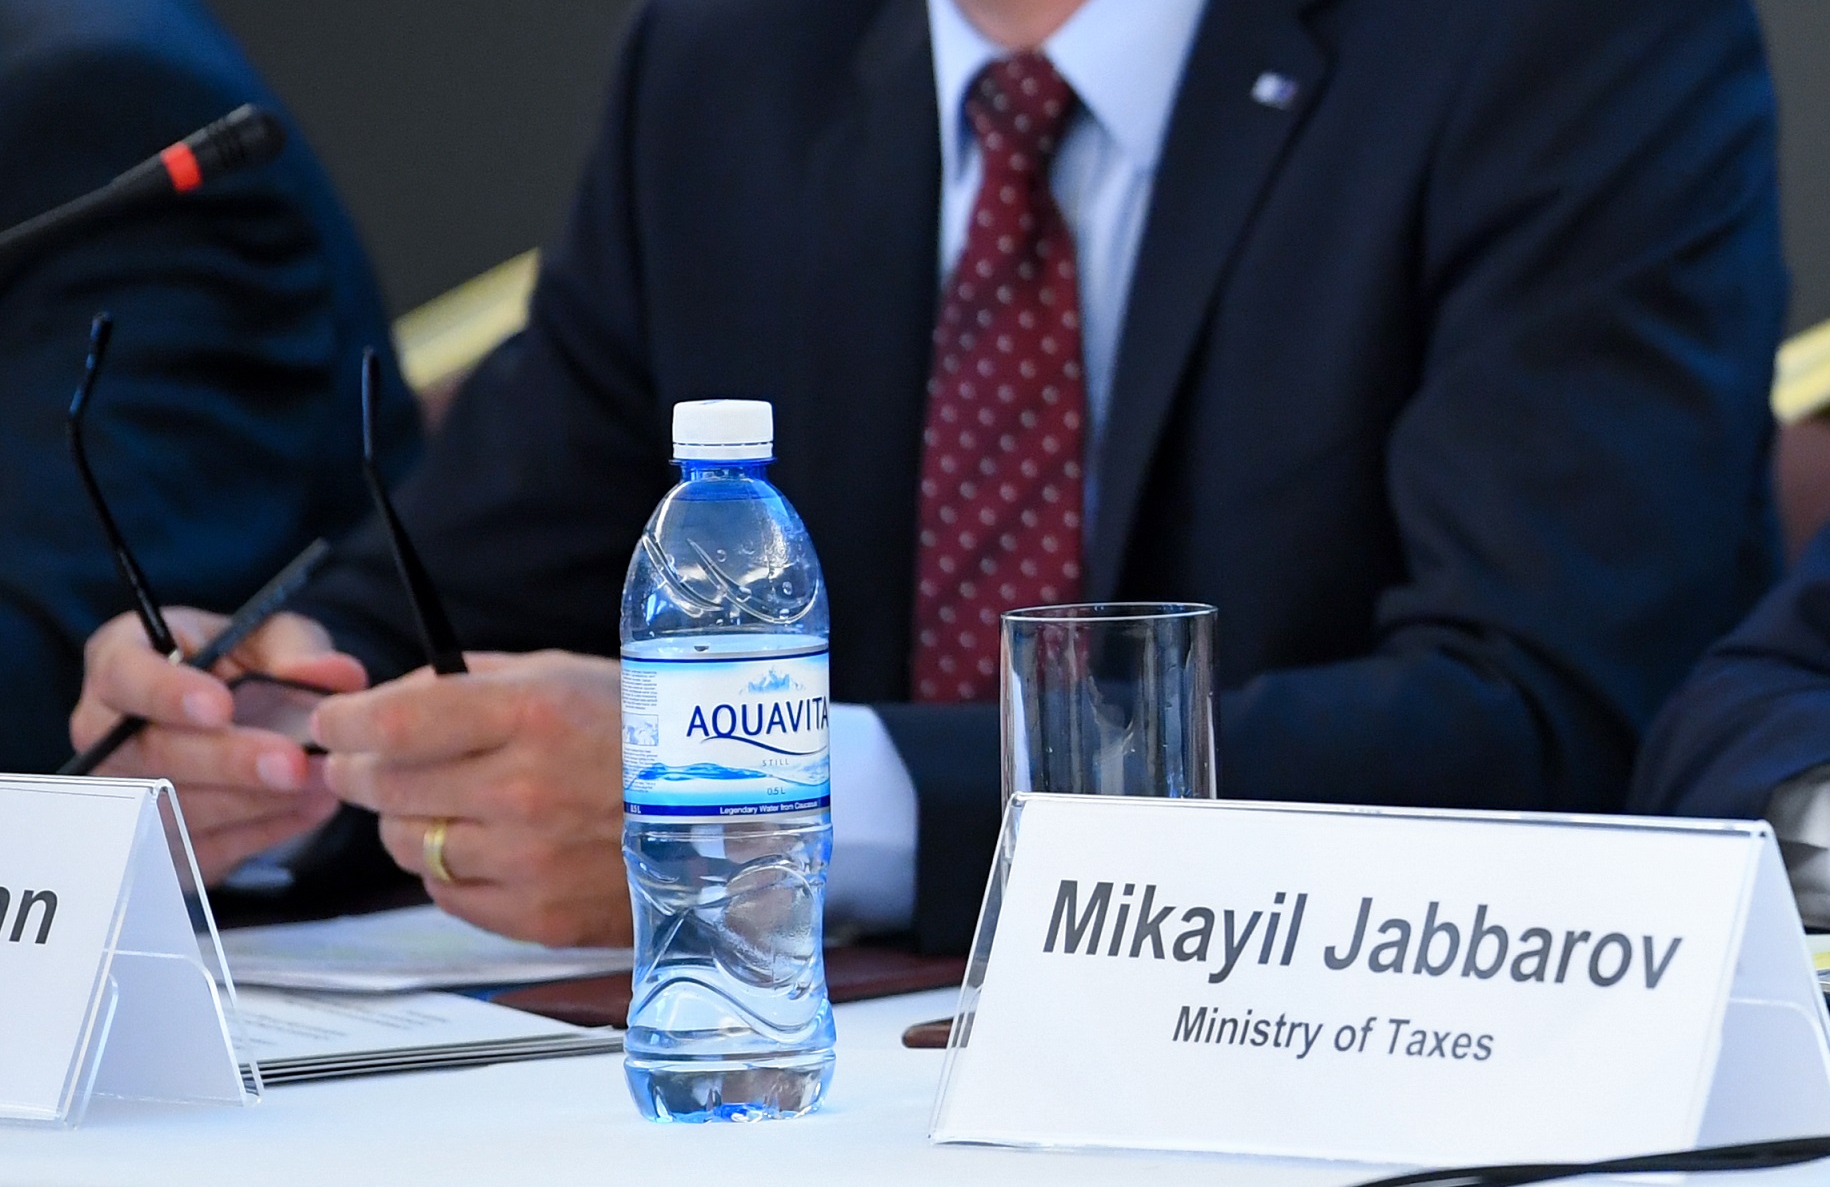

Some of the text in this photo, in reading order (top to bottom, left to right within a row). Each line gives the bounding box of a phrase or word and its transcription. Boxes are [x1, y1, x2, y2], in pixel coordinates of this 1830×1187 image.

[686, 695, 829, 738] AQUAVITA
[762, 757, 790, 767] STILL
[720, 805, 758, 816] Legendary
[760, 804, 779, 813] Water
[1042, 879, 1682, 991] Mikayil Jabbarov
[1172, 1005, 1494, 1061] Ministry of Taxes
